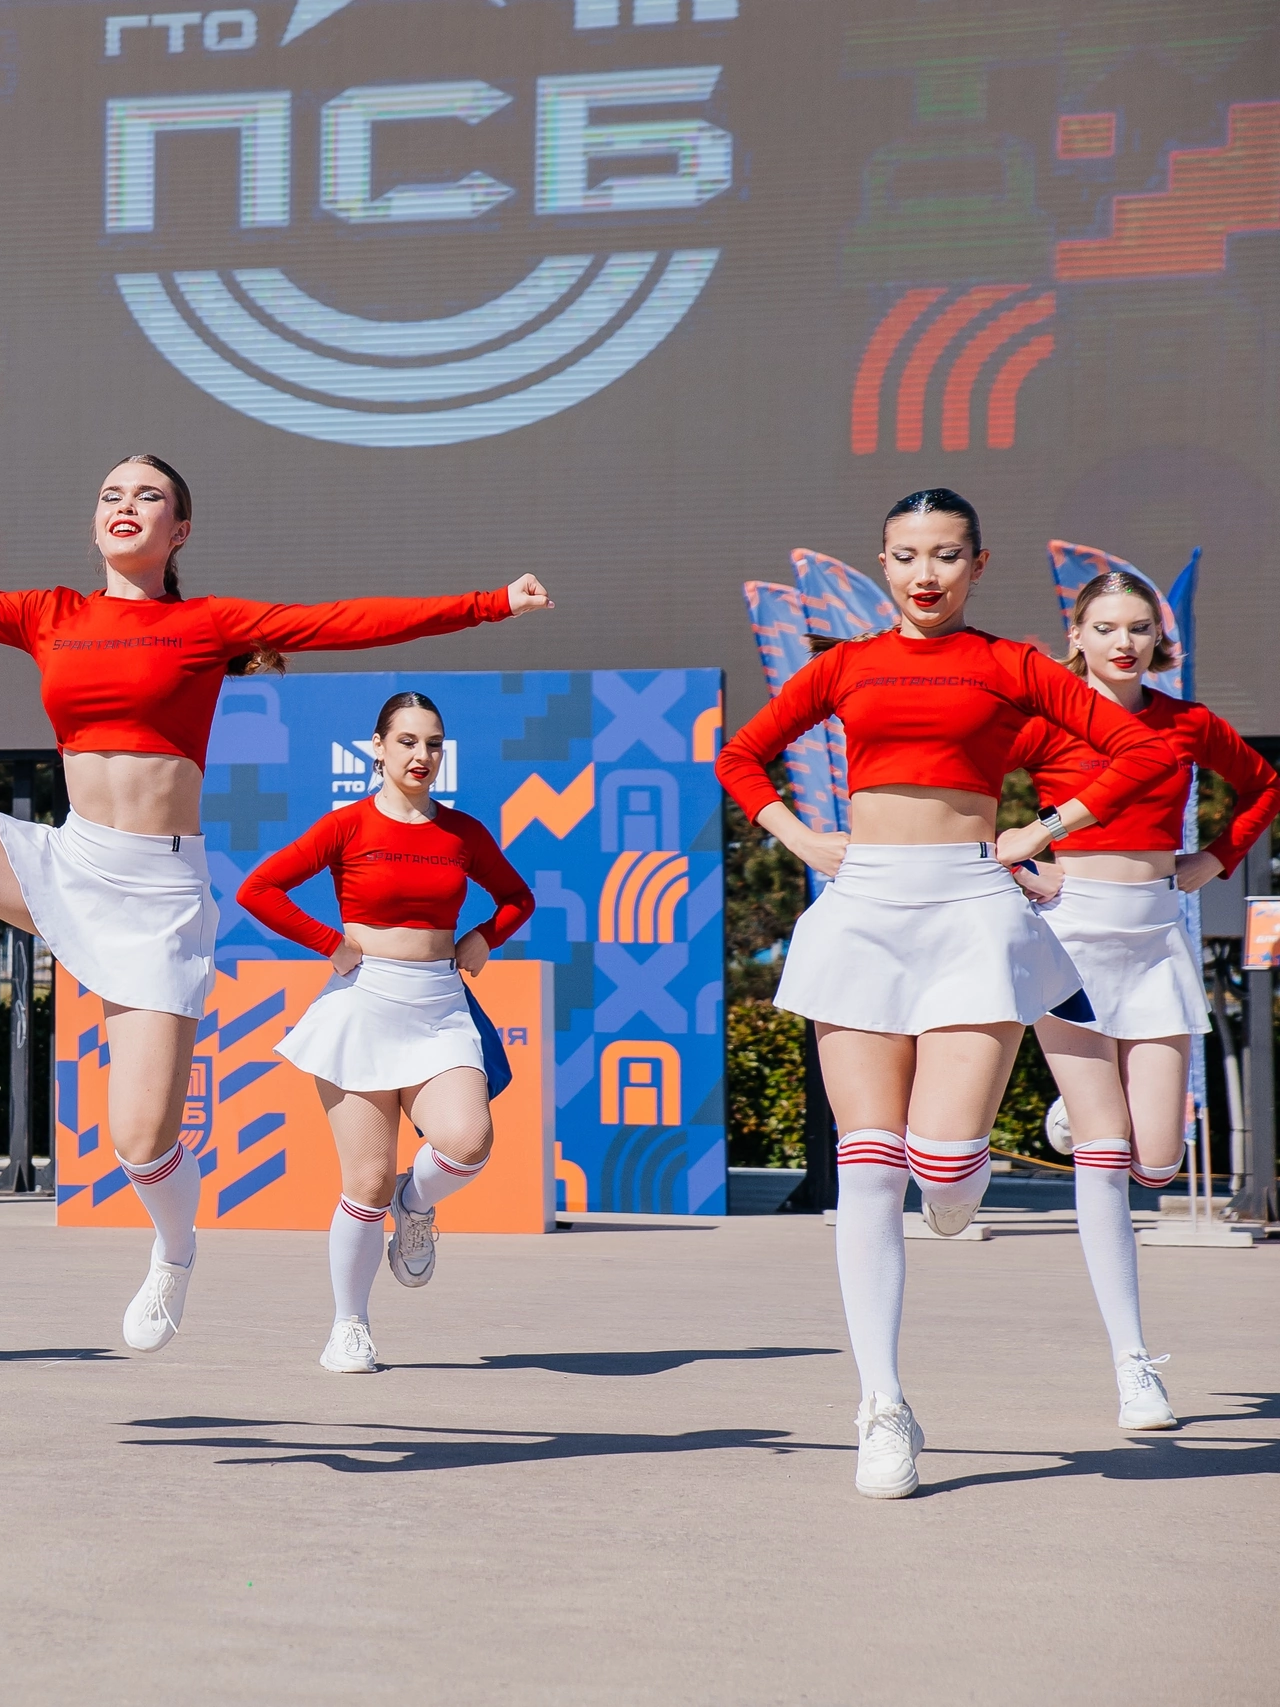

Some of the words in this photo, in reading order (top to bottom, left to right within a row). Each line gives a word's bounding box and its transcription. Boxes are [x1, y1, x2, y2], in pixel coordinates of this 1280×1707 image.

[105, 9, 258, 57] ГТО
[105, 65, 733, 234] ПСБ
[52, 636, 182, 651] SPARTANOCHKI
[332, 781, 366, 793] ГТО
